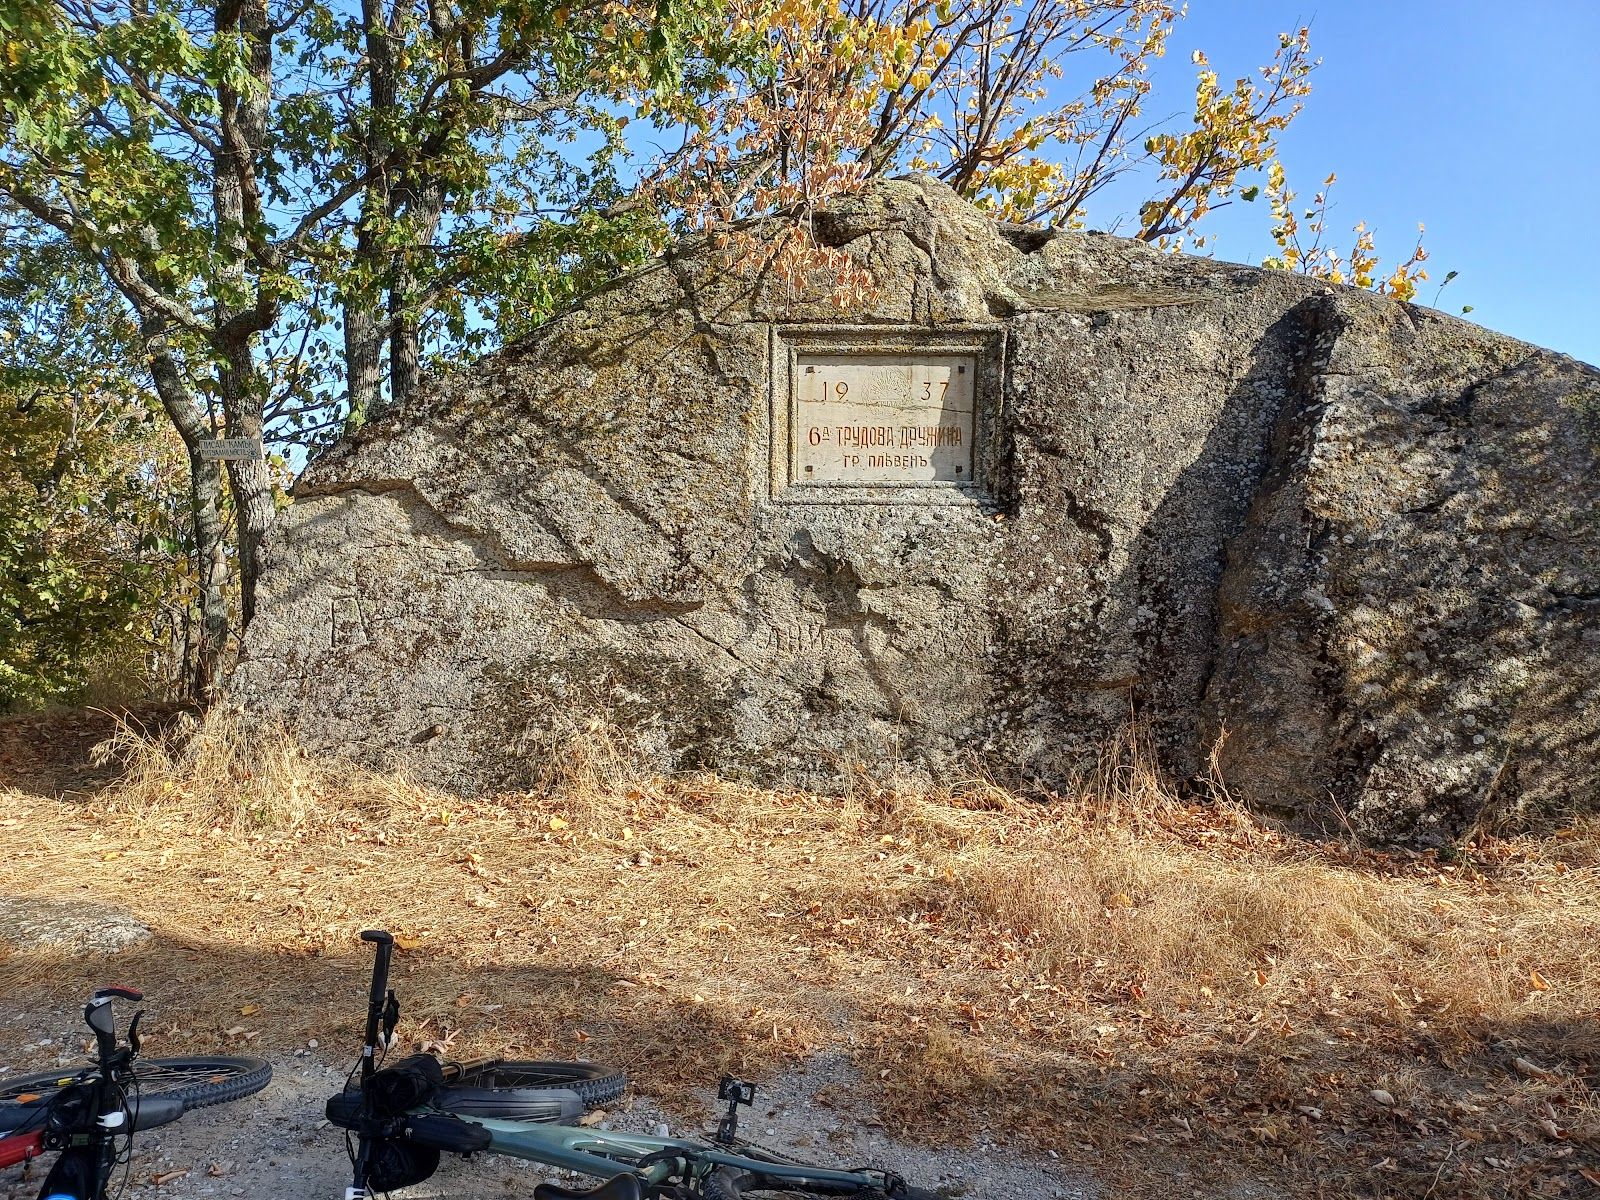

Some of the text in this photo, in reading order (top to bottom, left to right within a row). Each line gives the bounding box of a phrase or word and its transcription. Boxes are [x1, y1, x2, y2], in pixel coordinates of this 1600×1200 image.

[821, 381, 949, 401] 19 37
[836, 426, 894, 449] ТРУДОВА
[899, 426, 963, 449] ДРУЖИНА
